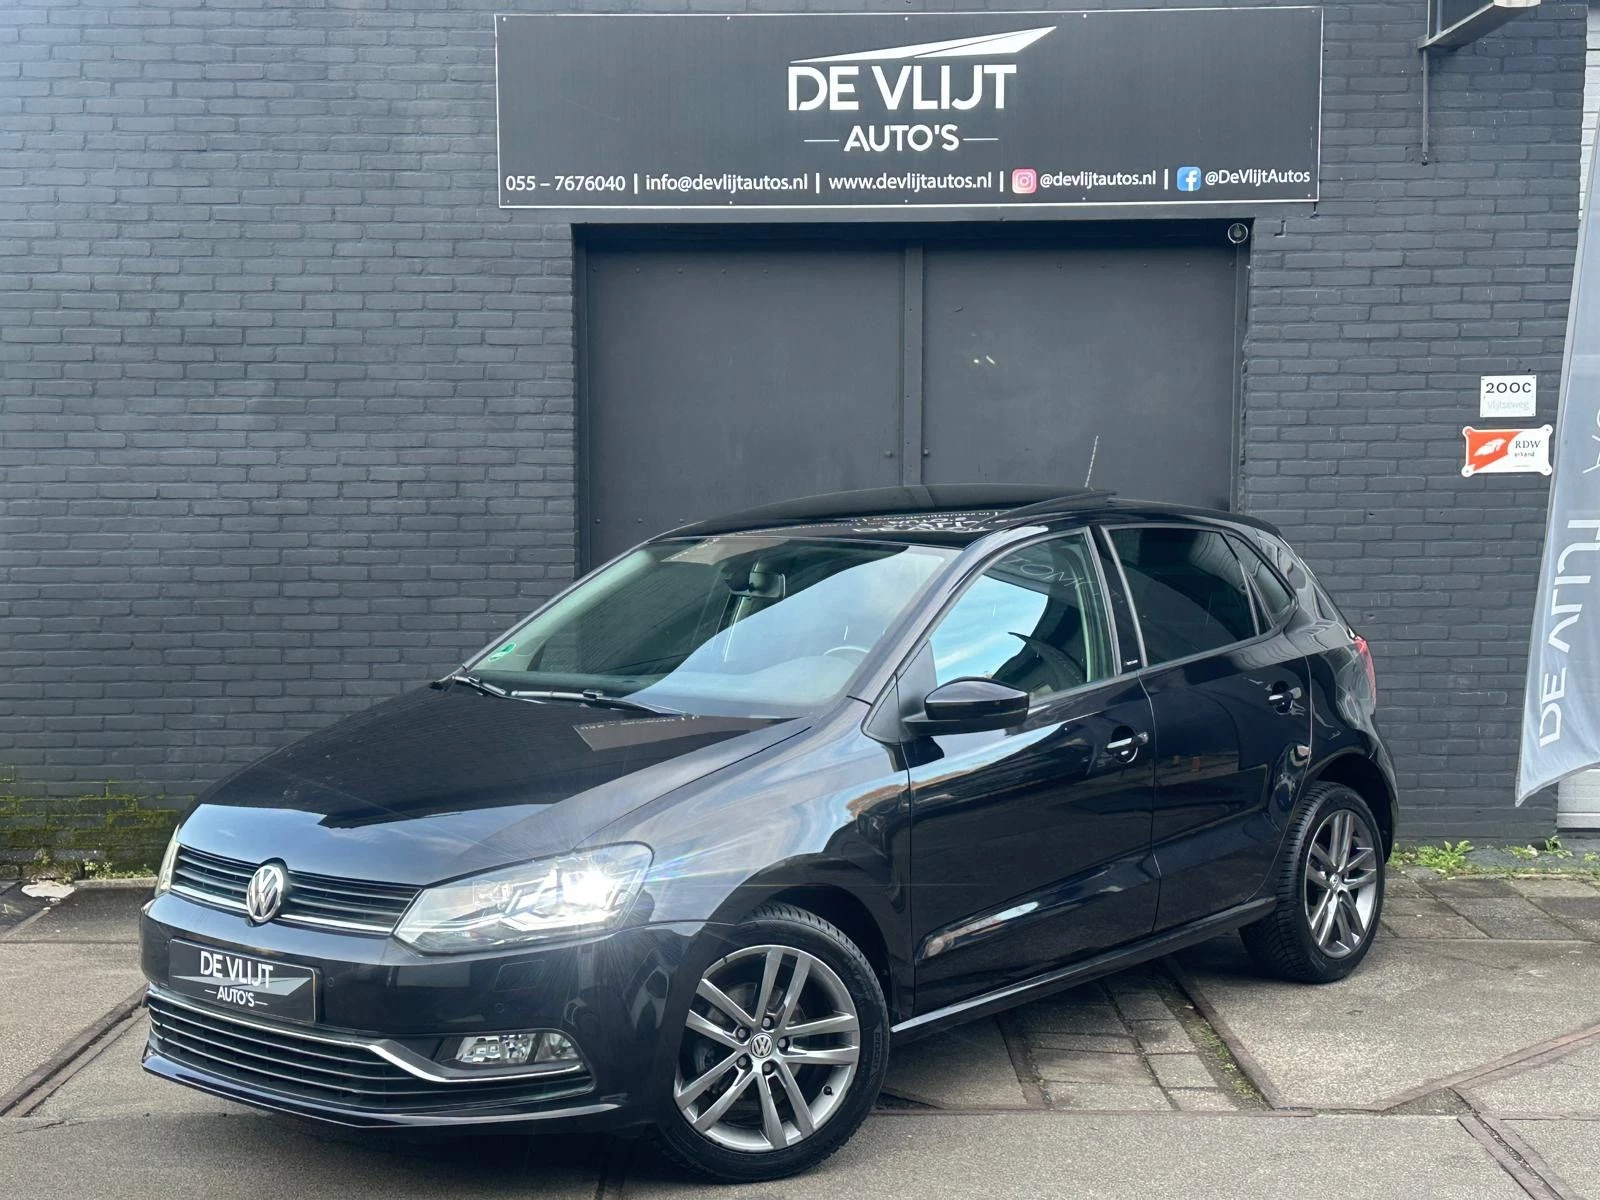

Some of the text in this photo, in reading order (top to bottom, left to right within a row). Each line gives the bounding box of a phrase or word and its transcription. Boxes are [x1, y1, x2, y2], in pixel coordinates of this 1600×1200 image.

[788, 64, 1017, 111] DE VLIJT
[844, 123, 960, 152] AUTO'S
[506, 176, 536, 191] 055
[555, 175, 626, 191] 7676040
[645, 173, 808, 194] info@devlijtautos.nl
[829, 172, 992, 193] www.devlijtautos.nl
[1040, 170, 1156, 189] @devlijtautos.nl
[1205, 168, 1310, 187] @DeVlijtAutos
[1515, 440, 1541, 449] RDW
[200, 950, 273, 988] DE VLIJT
[216, 986, 255, 1007] AUTO'S
